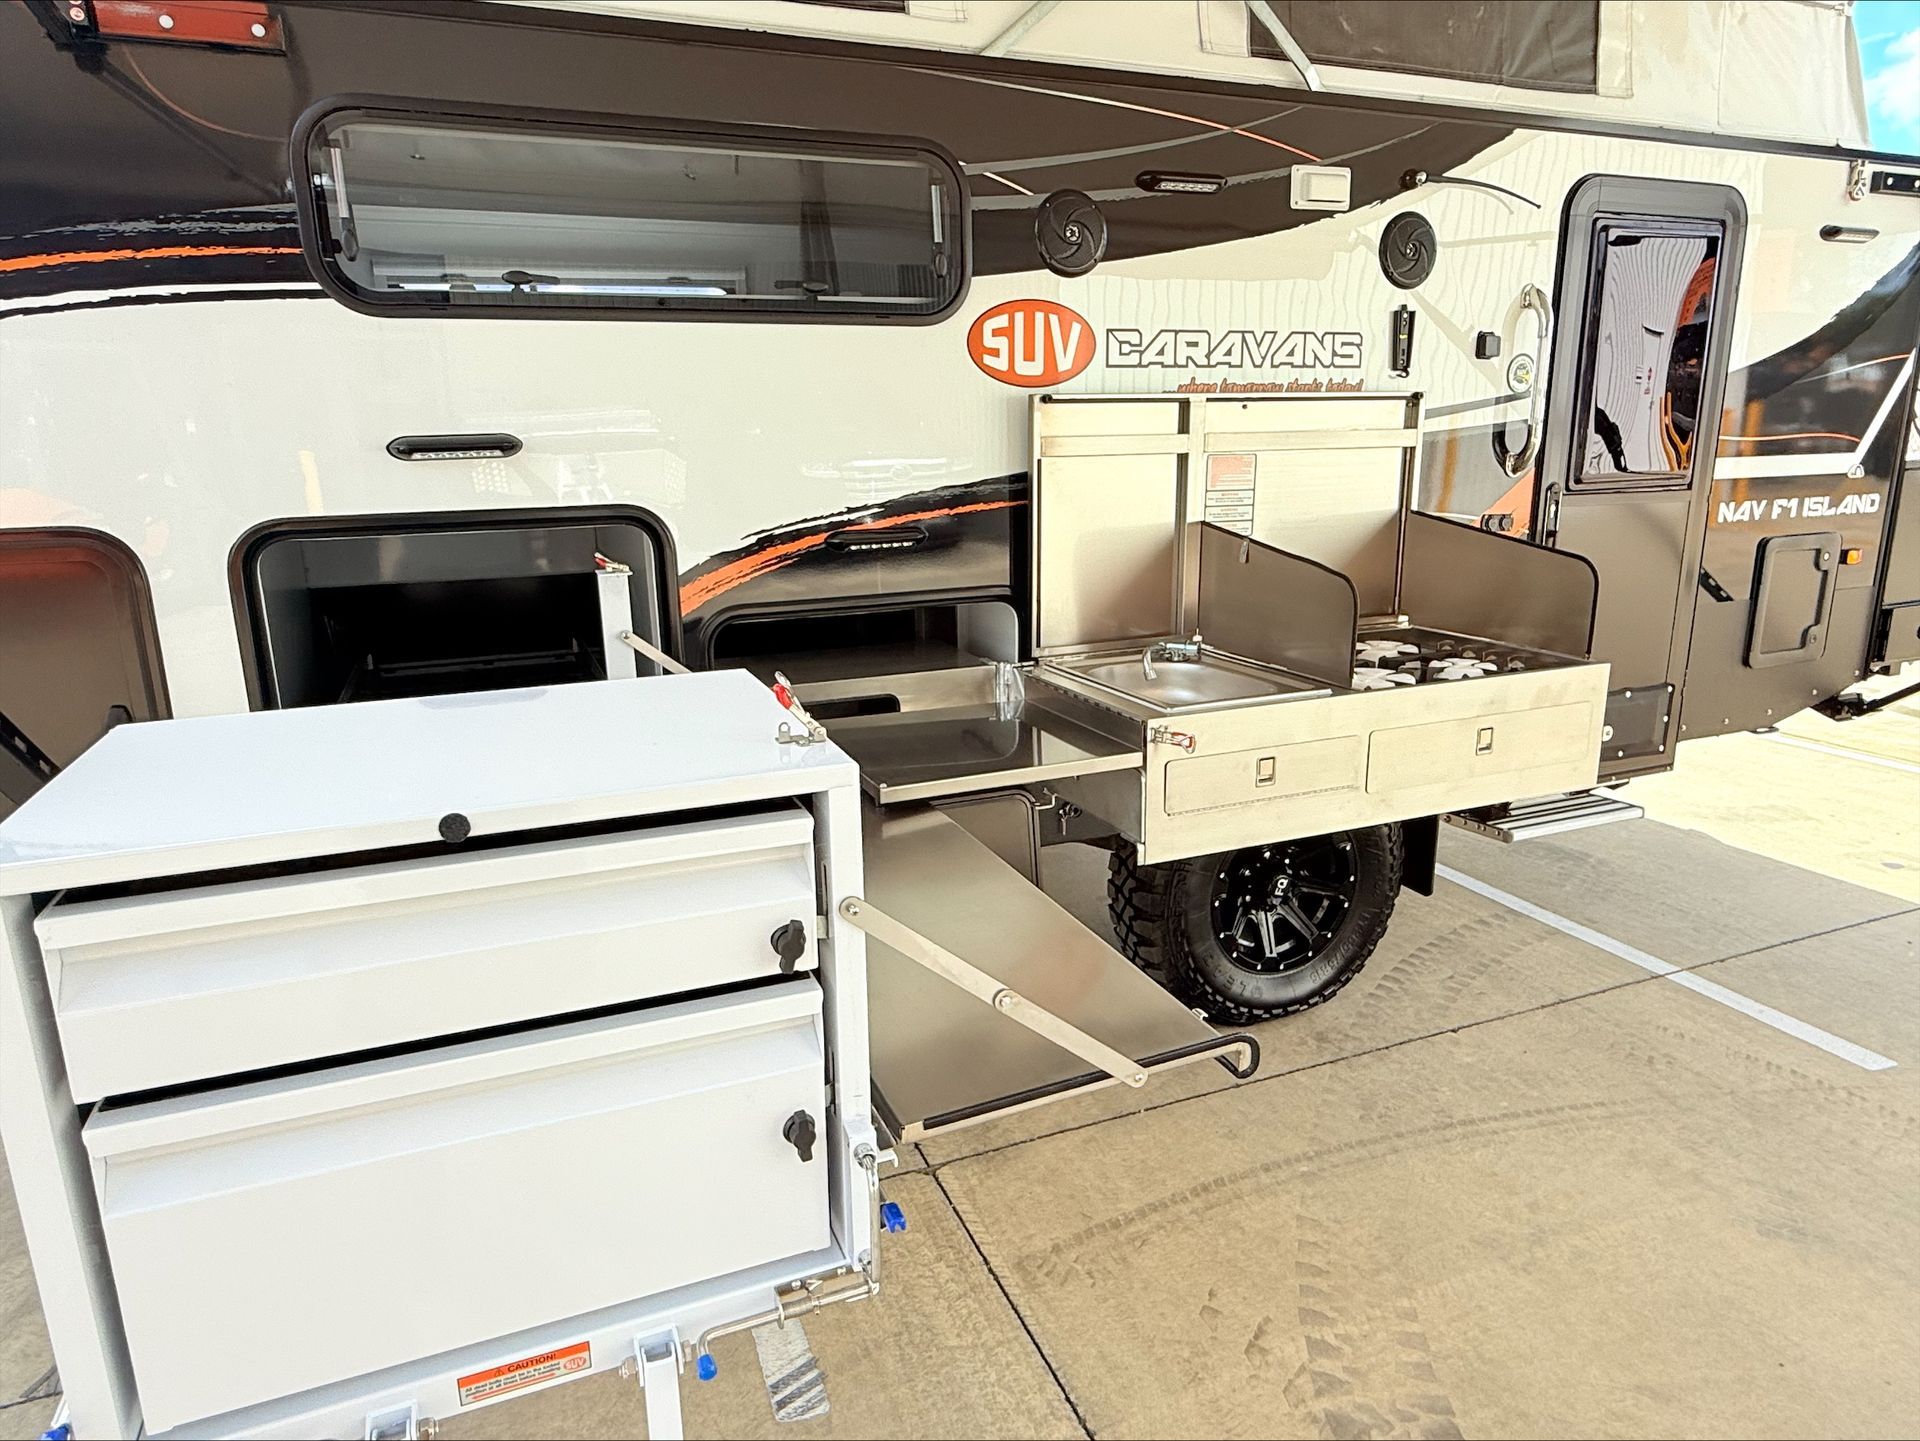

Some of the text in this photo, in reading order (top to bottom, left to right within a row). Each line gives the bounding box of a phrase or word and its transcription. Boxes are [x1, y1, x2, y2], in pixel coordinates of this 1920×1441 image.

[982, 311, 1363, 377] SUV CARAVANS
[1285, 377, 1324, 392] starts
[1717, 493, 1880, 523] NAV F1 ISLAND
[1274, 878, 1289, 897] FQ
[507, 1353, 555, 1372] CAUTION!
[564, 1357, 583, 1370] SUV
